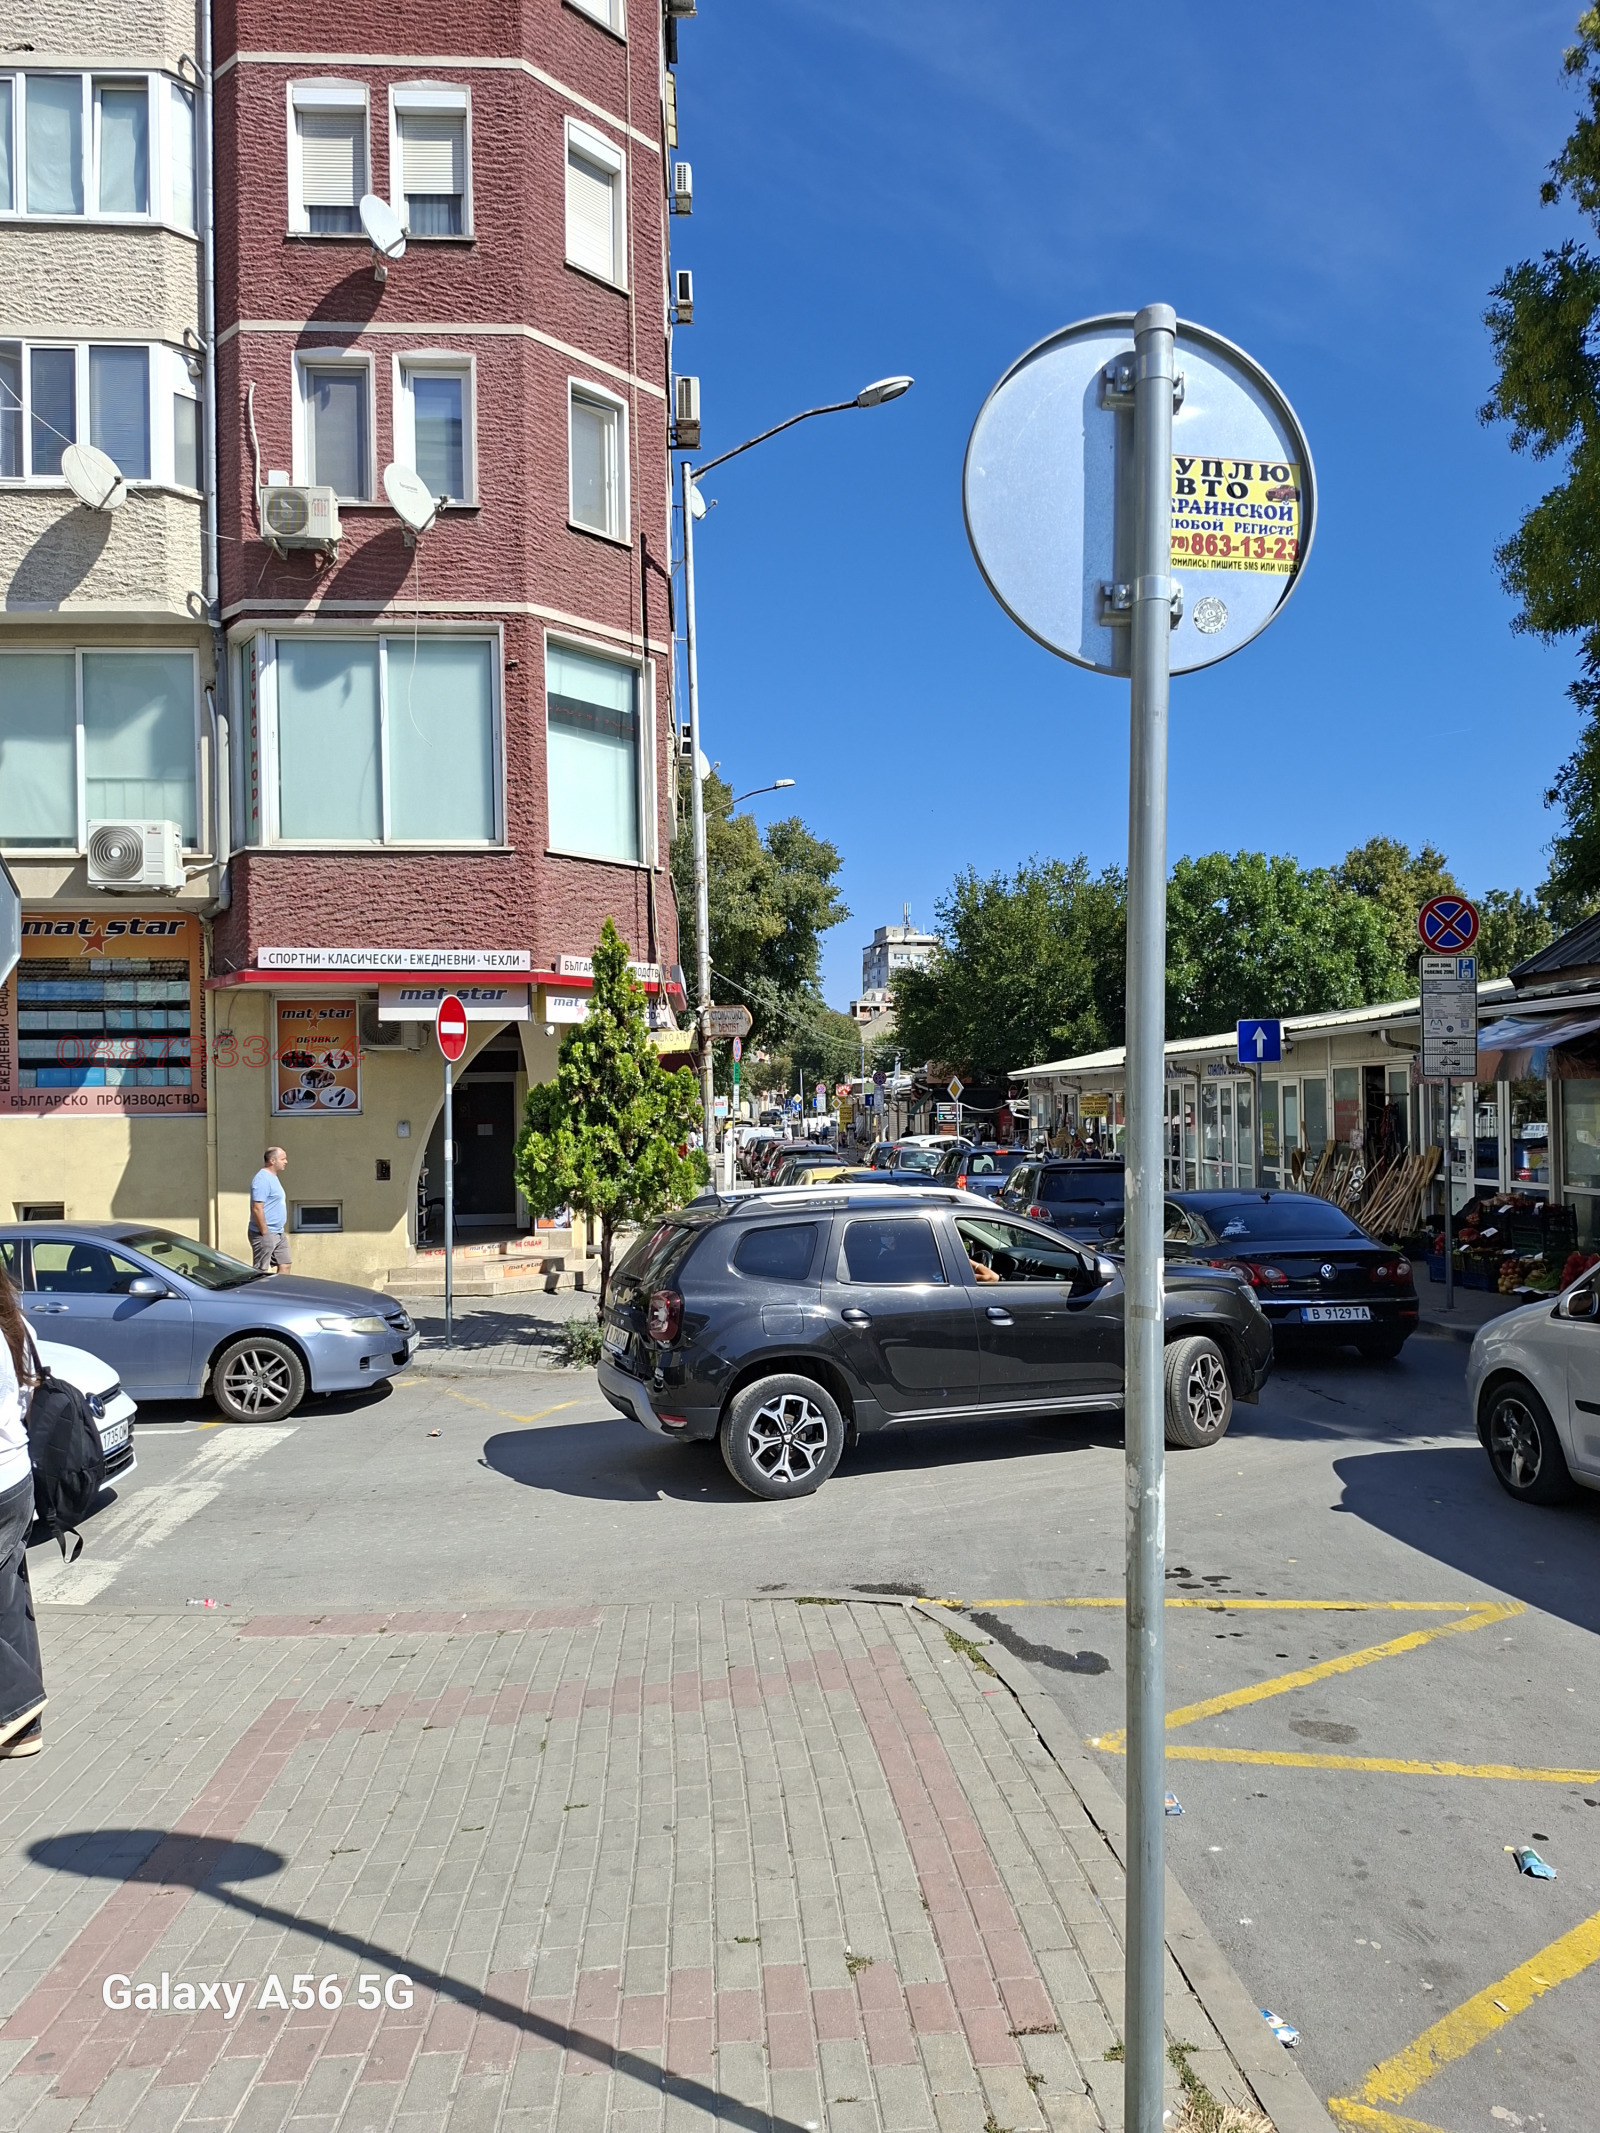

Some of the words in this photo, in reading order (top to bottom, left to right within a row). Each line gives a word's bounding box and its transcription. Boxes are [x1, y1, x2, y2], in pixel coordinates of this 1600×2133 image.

[1175, 457, 1290, 482] УПЛЮ
[1175, 477, 1249, 499] ВТО
[1171, 498, 1294, 521] РАИНСКОЙ
[1171, 518, 1224, 531] ЮБОЙ
[1171, 535, 1190, 552] 78)
[1190, 532, 1299, 561] 863-13-23
[1172, 557, 1210, 568] ОНИЛИСЬ!
[1210, 559, 1242, 570] ПИШИТЕ
[1243, 561, 1259, 571] SMS
[1260, 562, 1276, 572] ИЛИ
[22, 918, 95, 936] mat
[105, 918, 187, 936] star
[268, 953, 321, 965] СПОРТНИ
[328, 954, 402, 966] КЛАСИЧЕСКИ
[409, 954, 475, 967] ЕЖЕДНЕВНИ
[483, 955, 520, 966] ЧЕХЛИ
[564, 961, 593, 973] БЪЛГАР
[400, 987, 449, 1000] mat
[456, 987, 508, 1001] star
[554, 997, 580, 1007] mat
[281, 1007, 312, 1019] mat
[318, 1007, 354, 1019] star
[718, 1023, 740, 1033] DENTIST
[296, 1036, 339, 1044] ОБУВКИ
[0, 1024, 11, 1092] ЕЖЕДНЕВНИ
[11, 1095, 88, 1107] БЪЛГАРСКО
[97, 1094, 200, 1107] ПРОИЗВОДСТВО
[1325, 1308, 1352, 1319] 9129
[1352, 1308, 1369, 1319] TA
